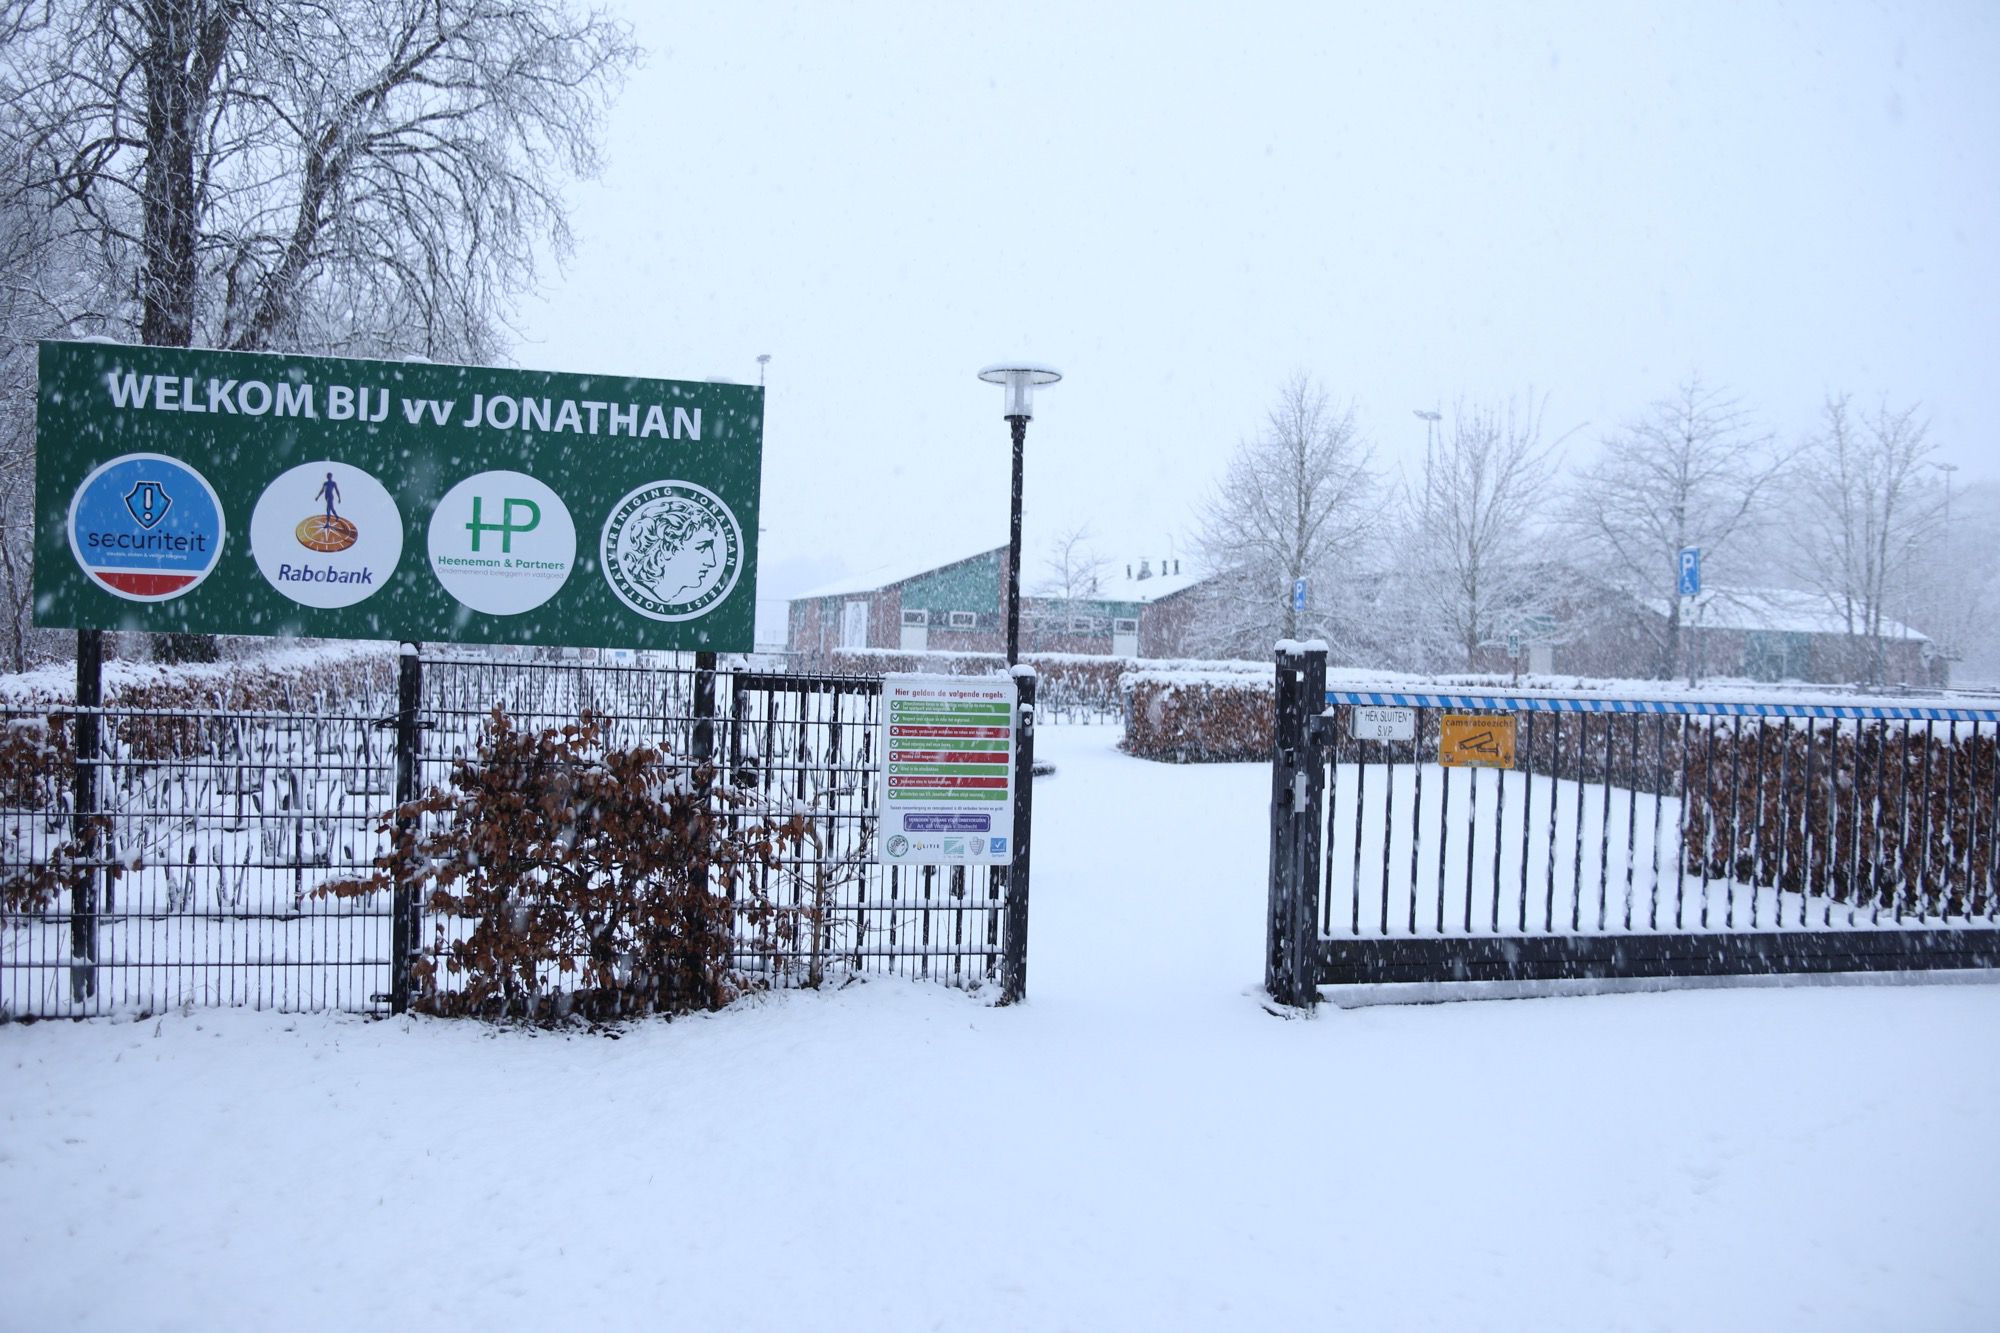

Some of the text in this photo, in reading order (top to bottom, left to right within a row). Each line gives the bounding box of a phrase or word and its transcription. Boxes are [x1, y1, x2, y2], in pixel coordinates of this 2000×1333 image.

[108, 372, 315, 419] WELKOM
[327, 384, 390, 424] BIJ
[463, 394, 702, 441] JONATHAN
[690, 491, 737, 567] JONATHAN
[88, 529, 207, 554] securiteit
[438, 555, 565, 571] Heeneman & Partners
[1682, 553, 1694, 577] P
[278, 564, 373, 585] Rabobank
[533, 571, 565, 580] vastgoed
[686, 582, 725, 612] ZEIST
[1296, 583, 1303, 598] P
[895, 688, 909, 696] Hier
[912, 689, 935, 698] gelden
[937, 689, 947, 697] de
[949, 690, 980, 699] volgende
[1365, 710, 1407, 723] HEK SLUITEN
